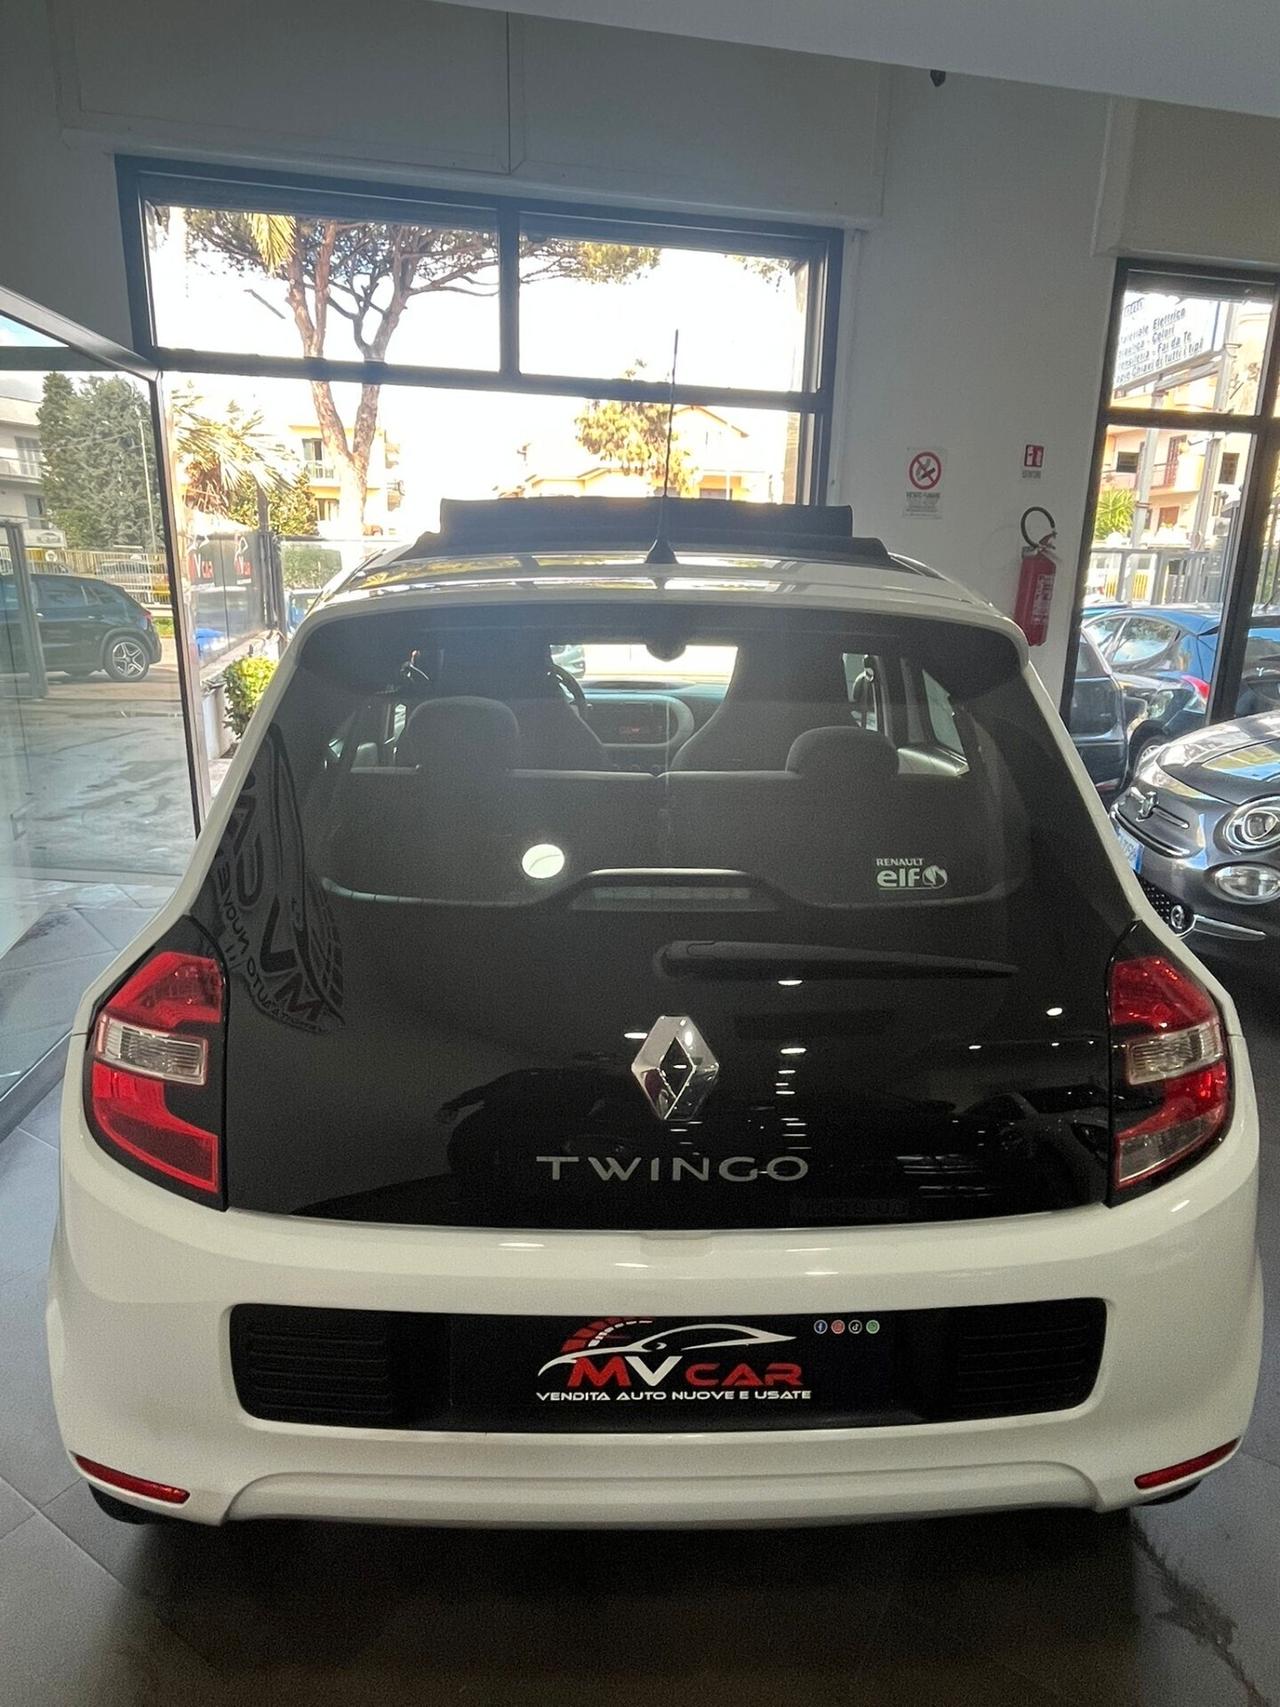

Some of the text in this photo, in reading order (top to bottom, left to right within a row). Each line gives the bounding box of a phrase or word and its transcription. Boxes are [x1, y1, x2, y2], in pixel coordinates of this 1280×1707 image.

[876, 858, 924, 867] RENAULT
[876, 868, 921, 887] elf
[535, 1155, 809, 1182] TWINGO
[567, 1355, 804, 1387] MV CAR
[536, 1390, 812, 1401] VENDITA AUTO NUOVE E USATE
